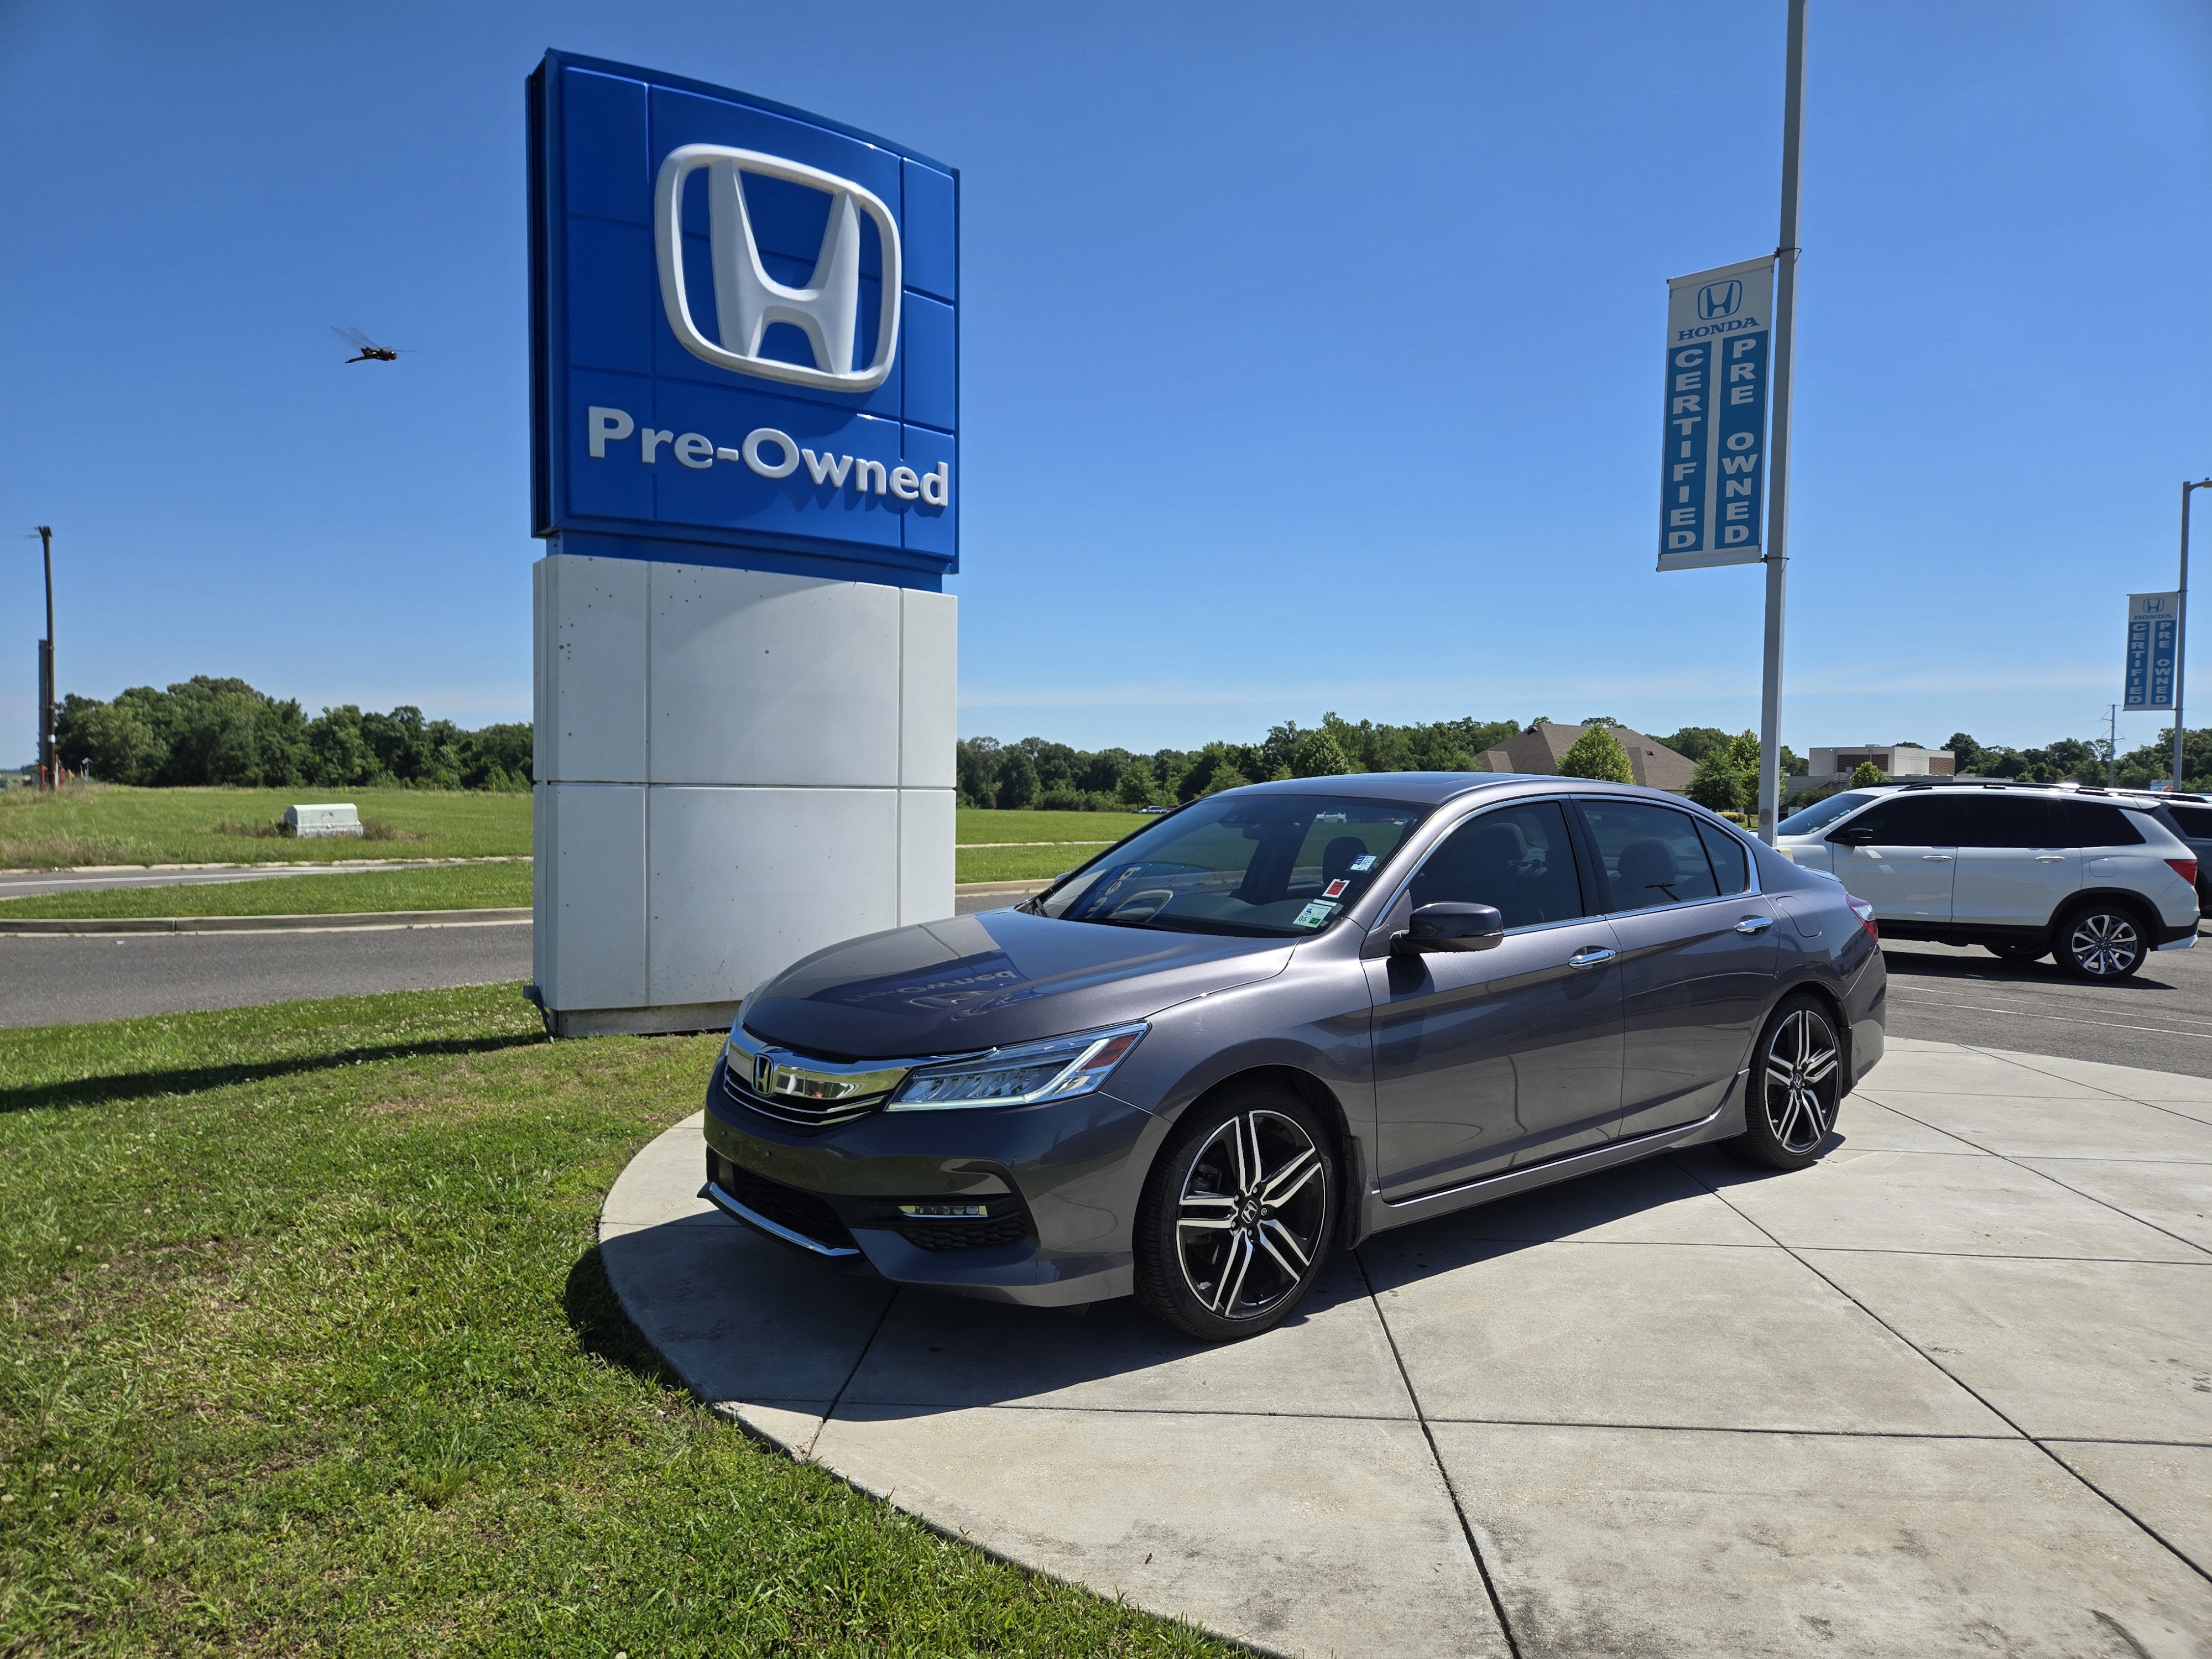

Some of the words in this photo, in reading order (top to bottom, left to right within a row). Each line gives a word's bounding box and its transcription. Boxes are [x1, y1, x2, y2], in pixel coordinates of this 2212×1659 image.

[1678, 317, 1759, 341] HONDA
[1730, 338, 1757, 405] PRE
[587, 405, 948, 507] Pre-Owned
[1668, 348, 1705, 549] CERTIFIED
[1722, 431, 1759, 544] OWNED
[2128, 623, 2146, 703] CERTIFIED
[2159, 622, 2171, 648] PRE
[2155, 659, 2171, 703] OWNED
